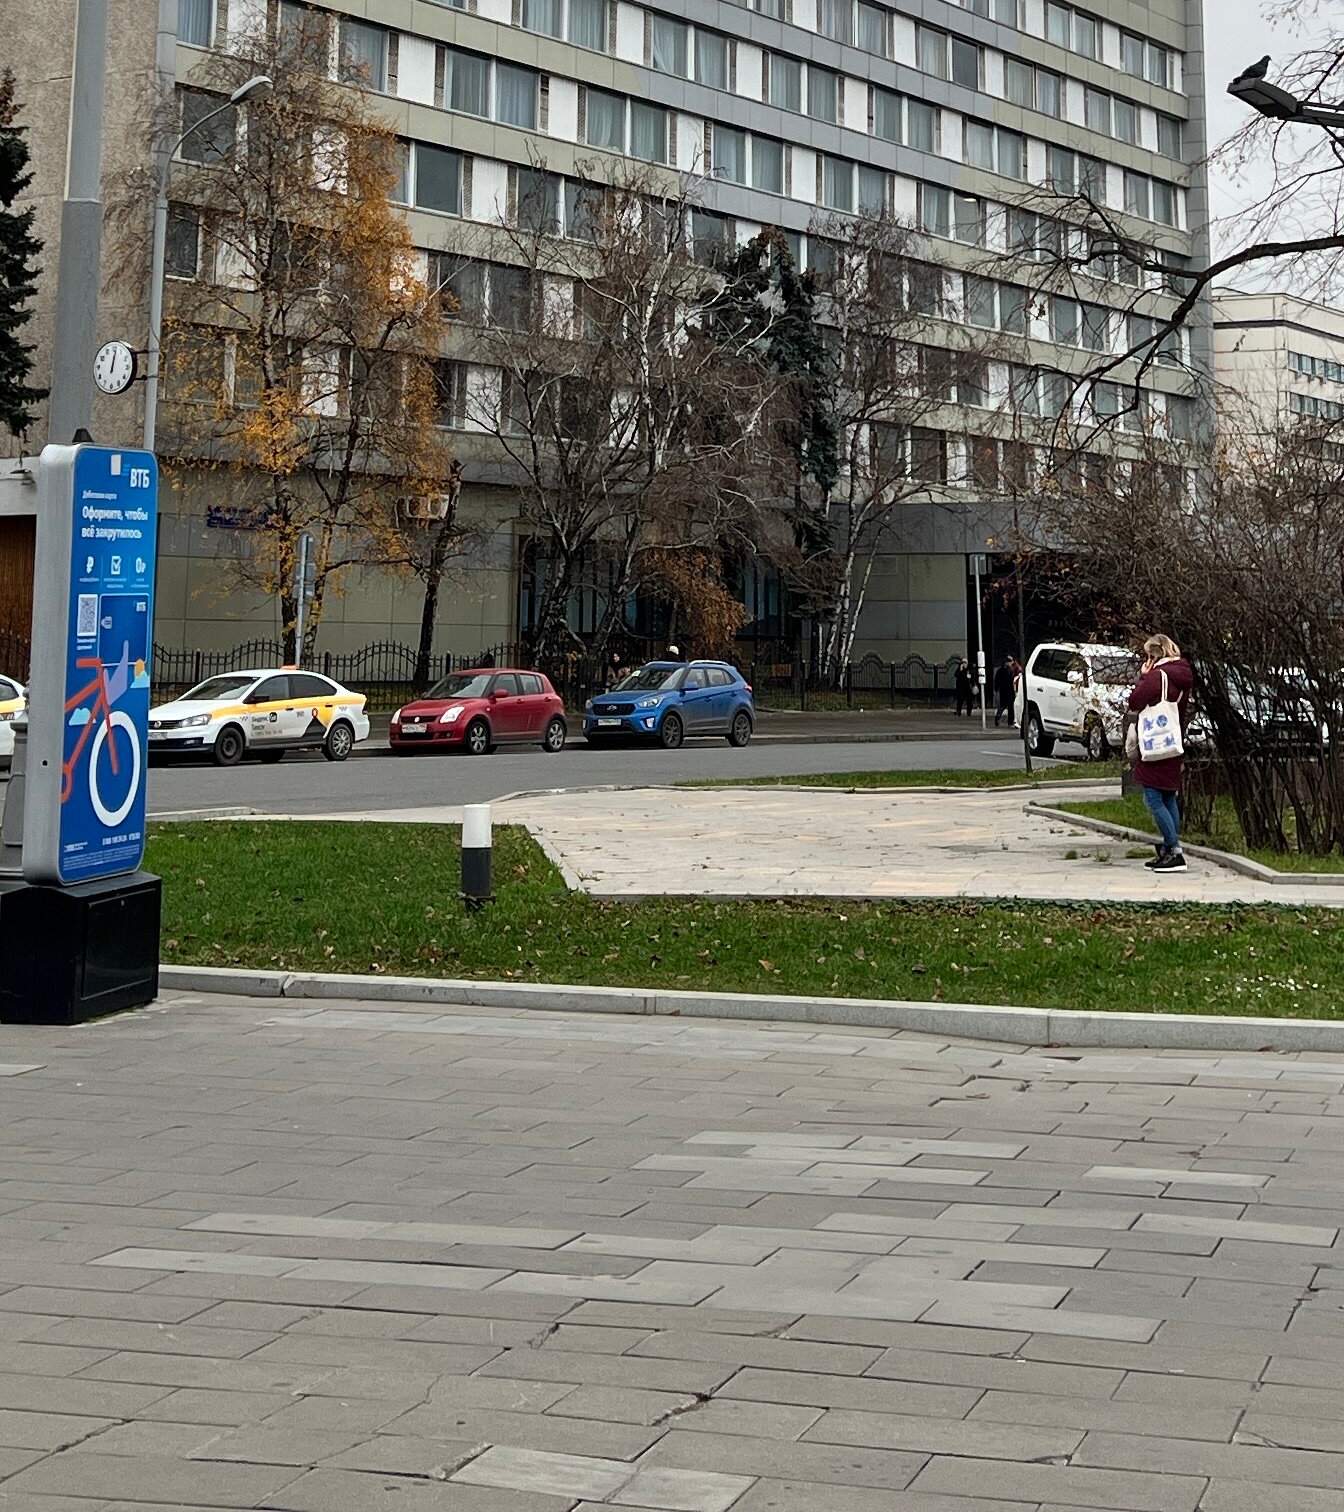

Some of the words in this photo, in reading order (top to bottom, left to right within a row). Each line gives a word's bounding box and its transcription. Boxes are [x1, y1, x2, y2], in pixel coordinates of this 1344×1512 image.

[130, 468, 150, 488] ВТБ
[125, 508, 149, 521] чтобы
[95, 528, 142, 541] закрутилось
